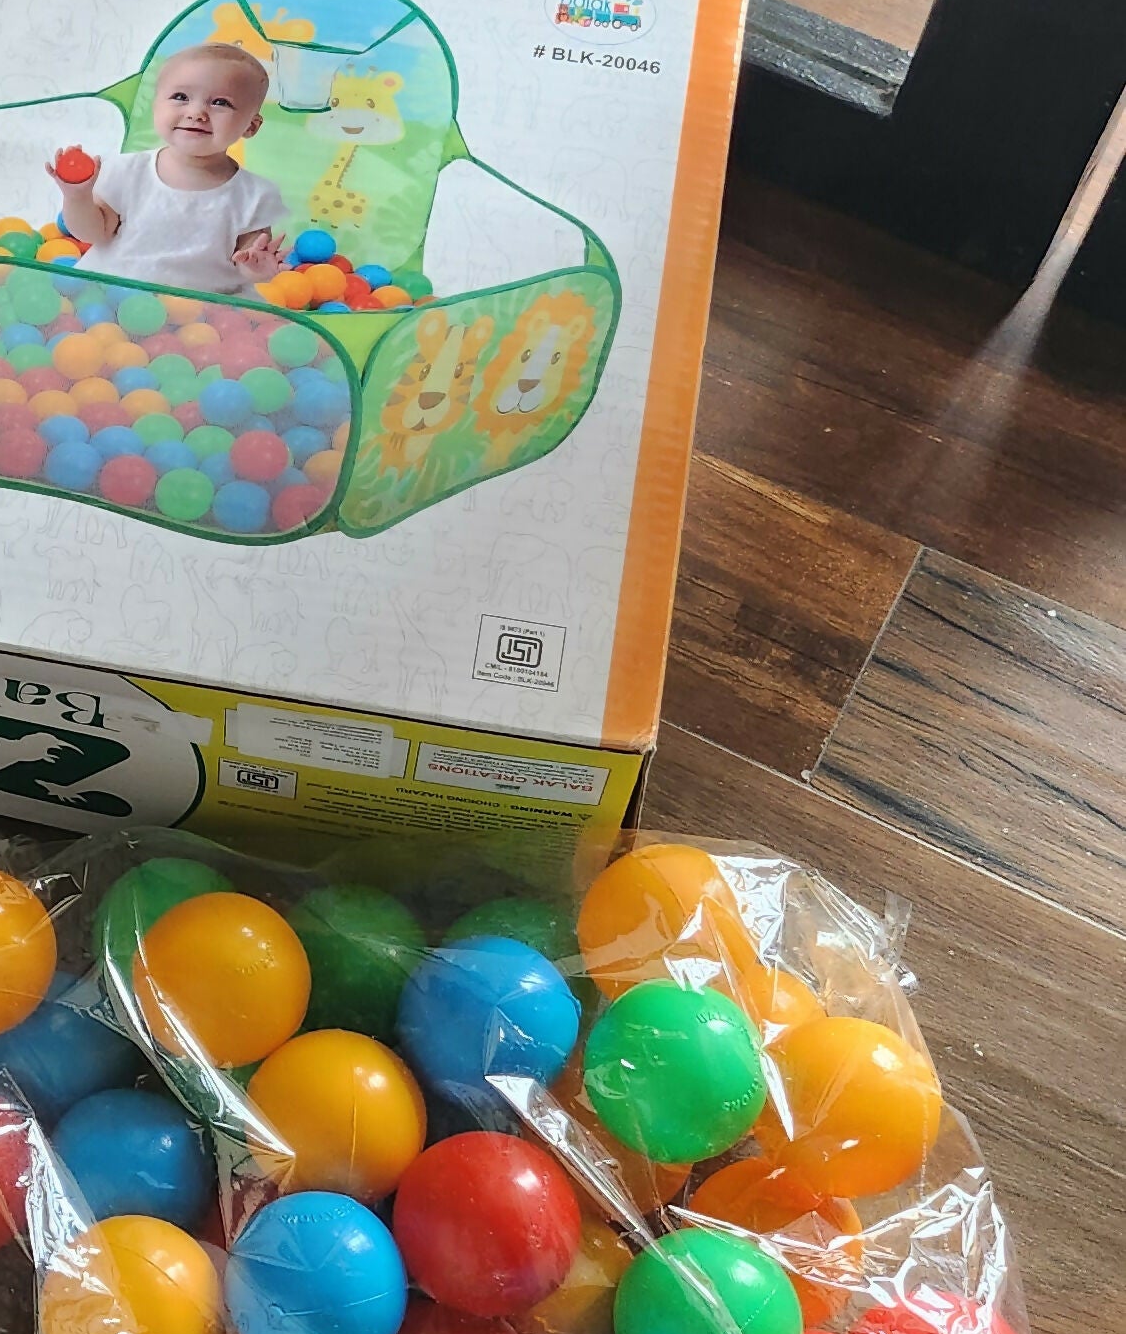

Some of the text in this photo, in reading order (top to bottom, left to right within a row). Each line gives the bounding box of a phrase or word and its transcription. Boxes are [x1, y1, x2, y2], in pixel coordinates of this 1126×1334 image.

[551, 47, 662, 74] BLK-20046
[427, 763, 528, 784] CREATIONS
[533, 779, 594, 792] BALAK
[447, 795, 501, 808] CHOKING
[509, 805, 573, 818] WARNING
